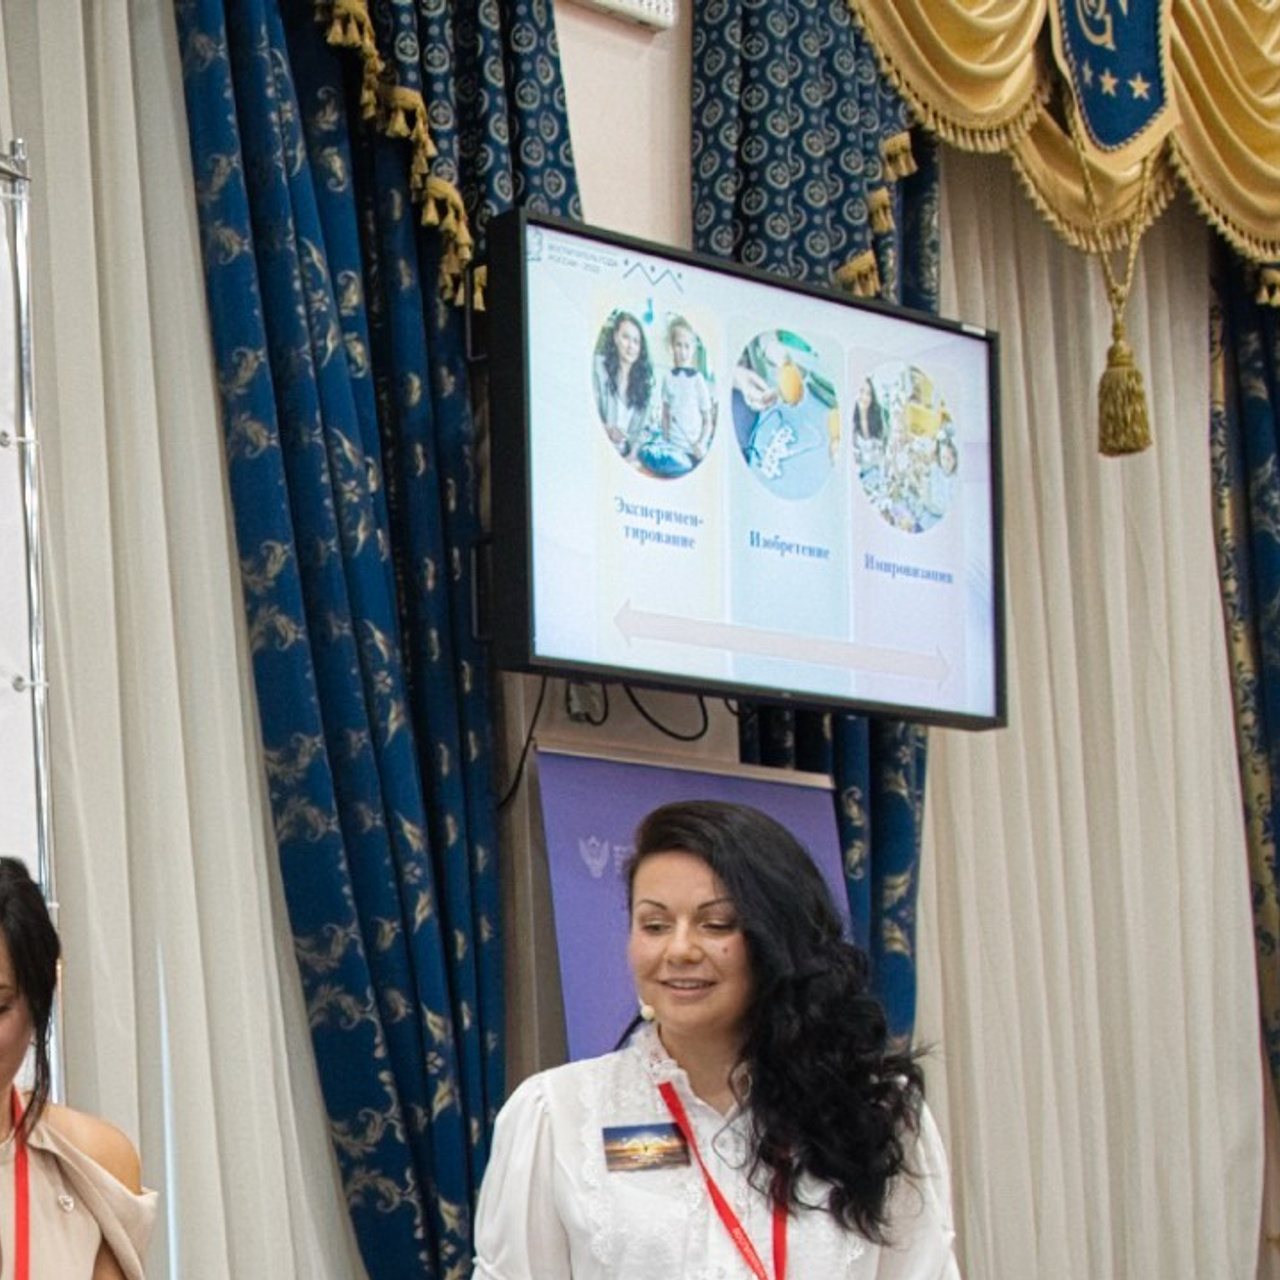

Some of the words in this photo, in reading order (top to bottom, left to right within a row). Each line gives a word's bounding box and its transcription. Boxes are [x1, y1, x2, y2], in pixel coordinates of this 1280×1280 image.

[614, 496, 704, 528] Эксперимен-
[623, 523, 696, 551] тирование
[749, 530, 830, 560] Изобретение
